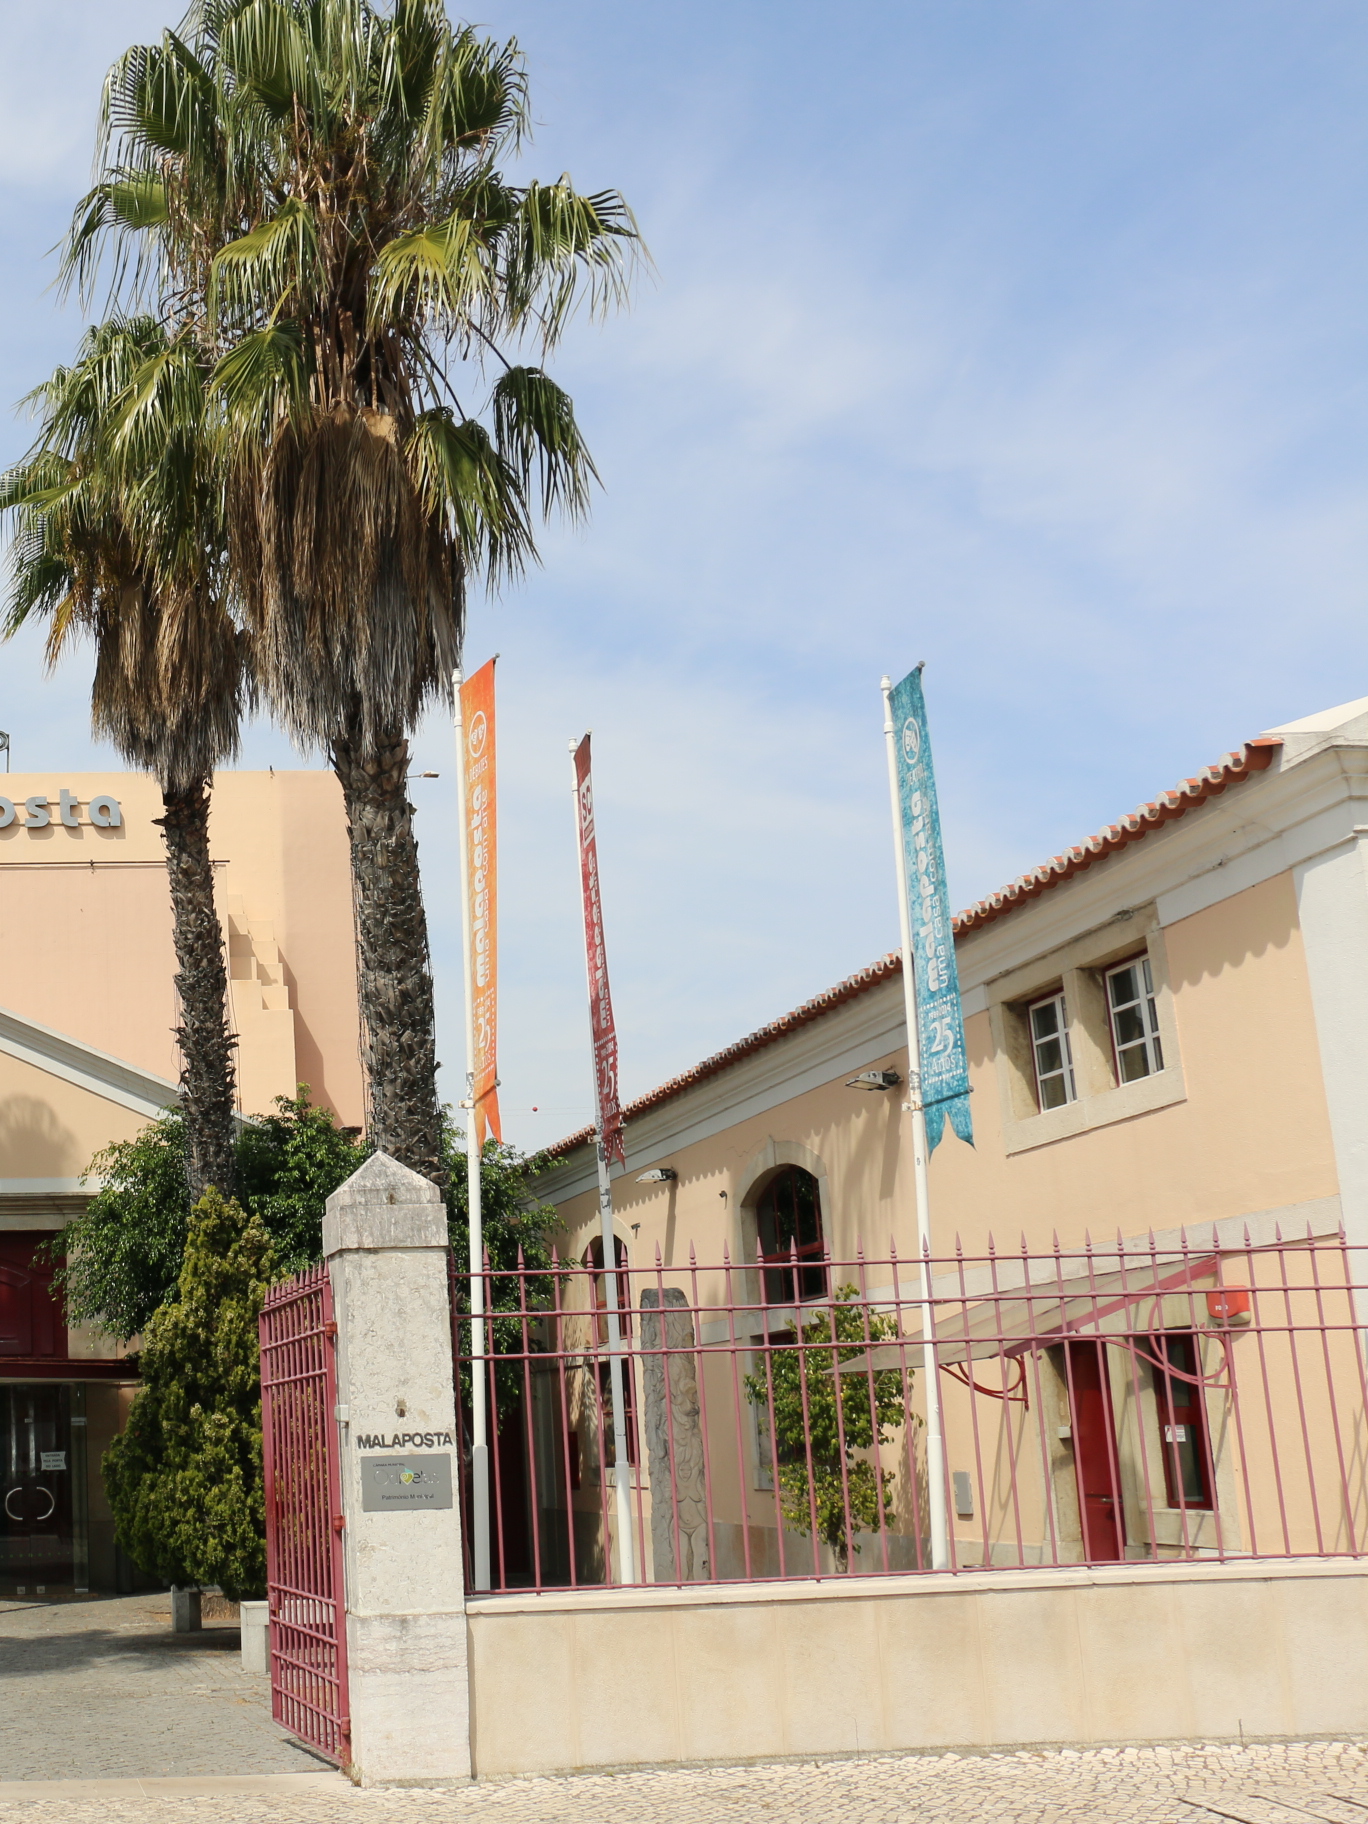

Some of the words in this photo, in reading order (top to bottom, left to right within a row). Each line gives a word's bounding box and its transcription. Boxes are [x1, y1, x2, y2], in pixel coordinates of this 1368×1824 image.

[470, 785, 486, 987] malaposta
[911, 791, 939, 992] malaposta
[933, 896, 943, 939] casa
[936, 945, 949, 988] uma
[929, 1016, 954, 1058] 25
[601, 1056, 614, 1099] 25
[357, 1432, 453, 1449] MALAPOSTA
